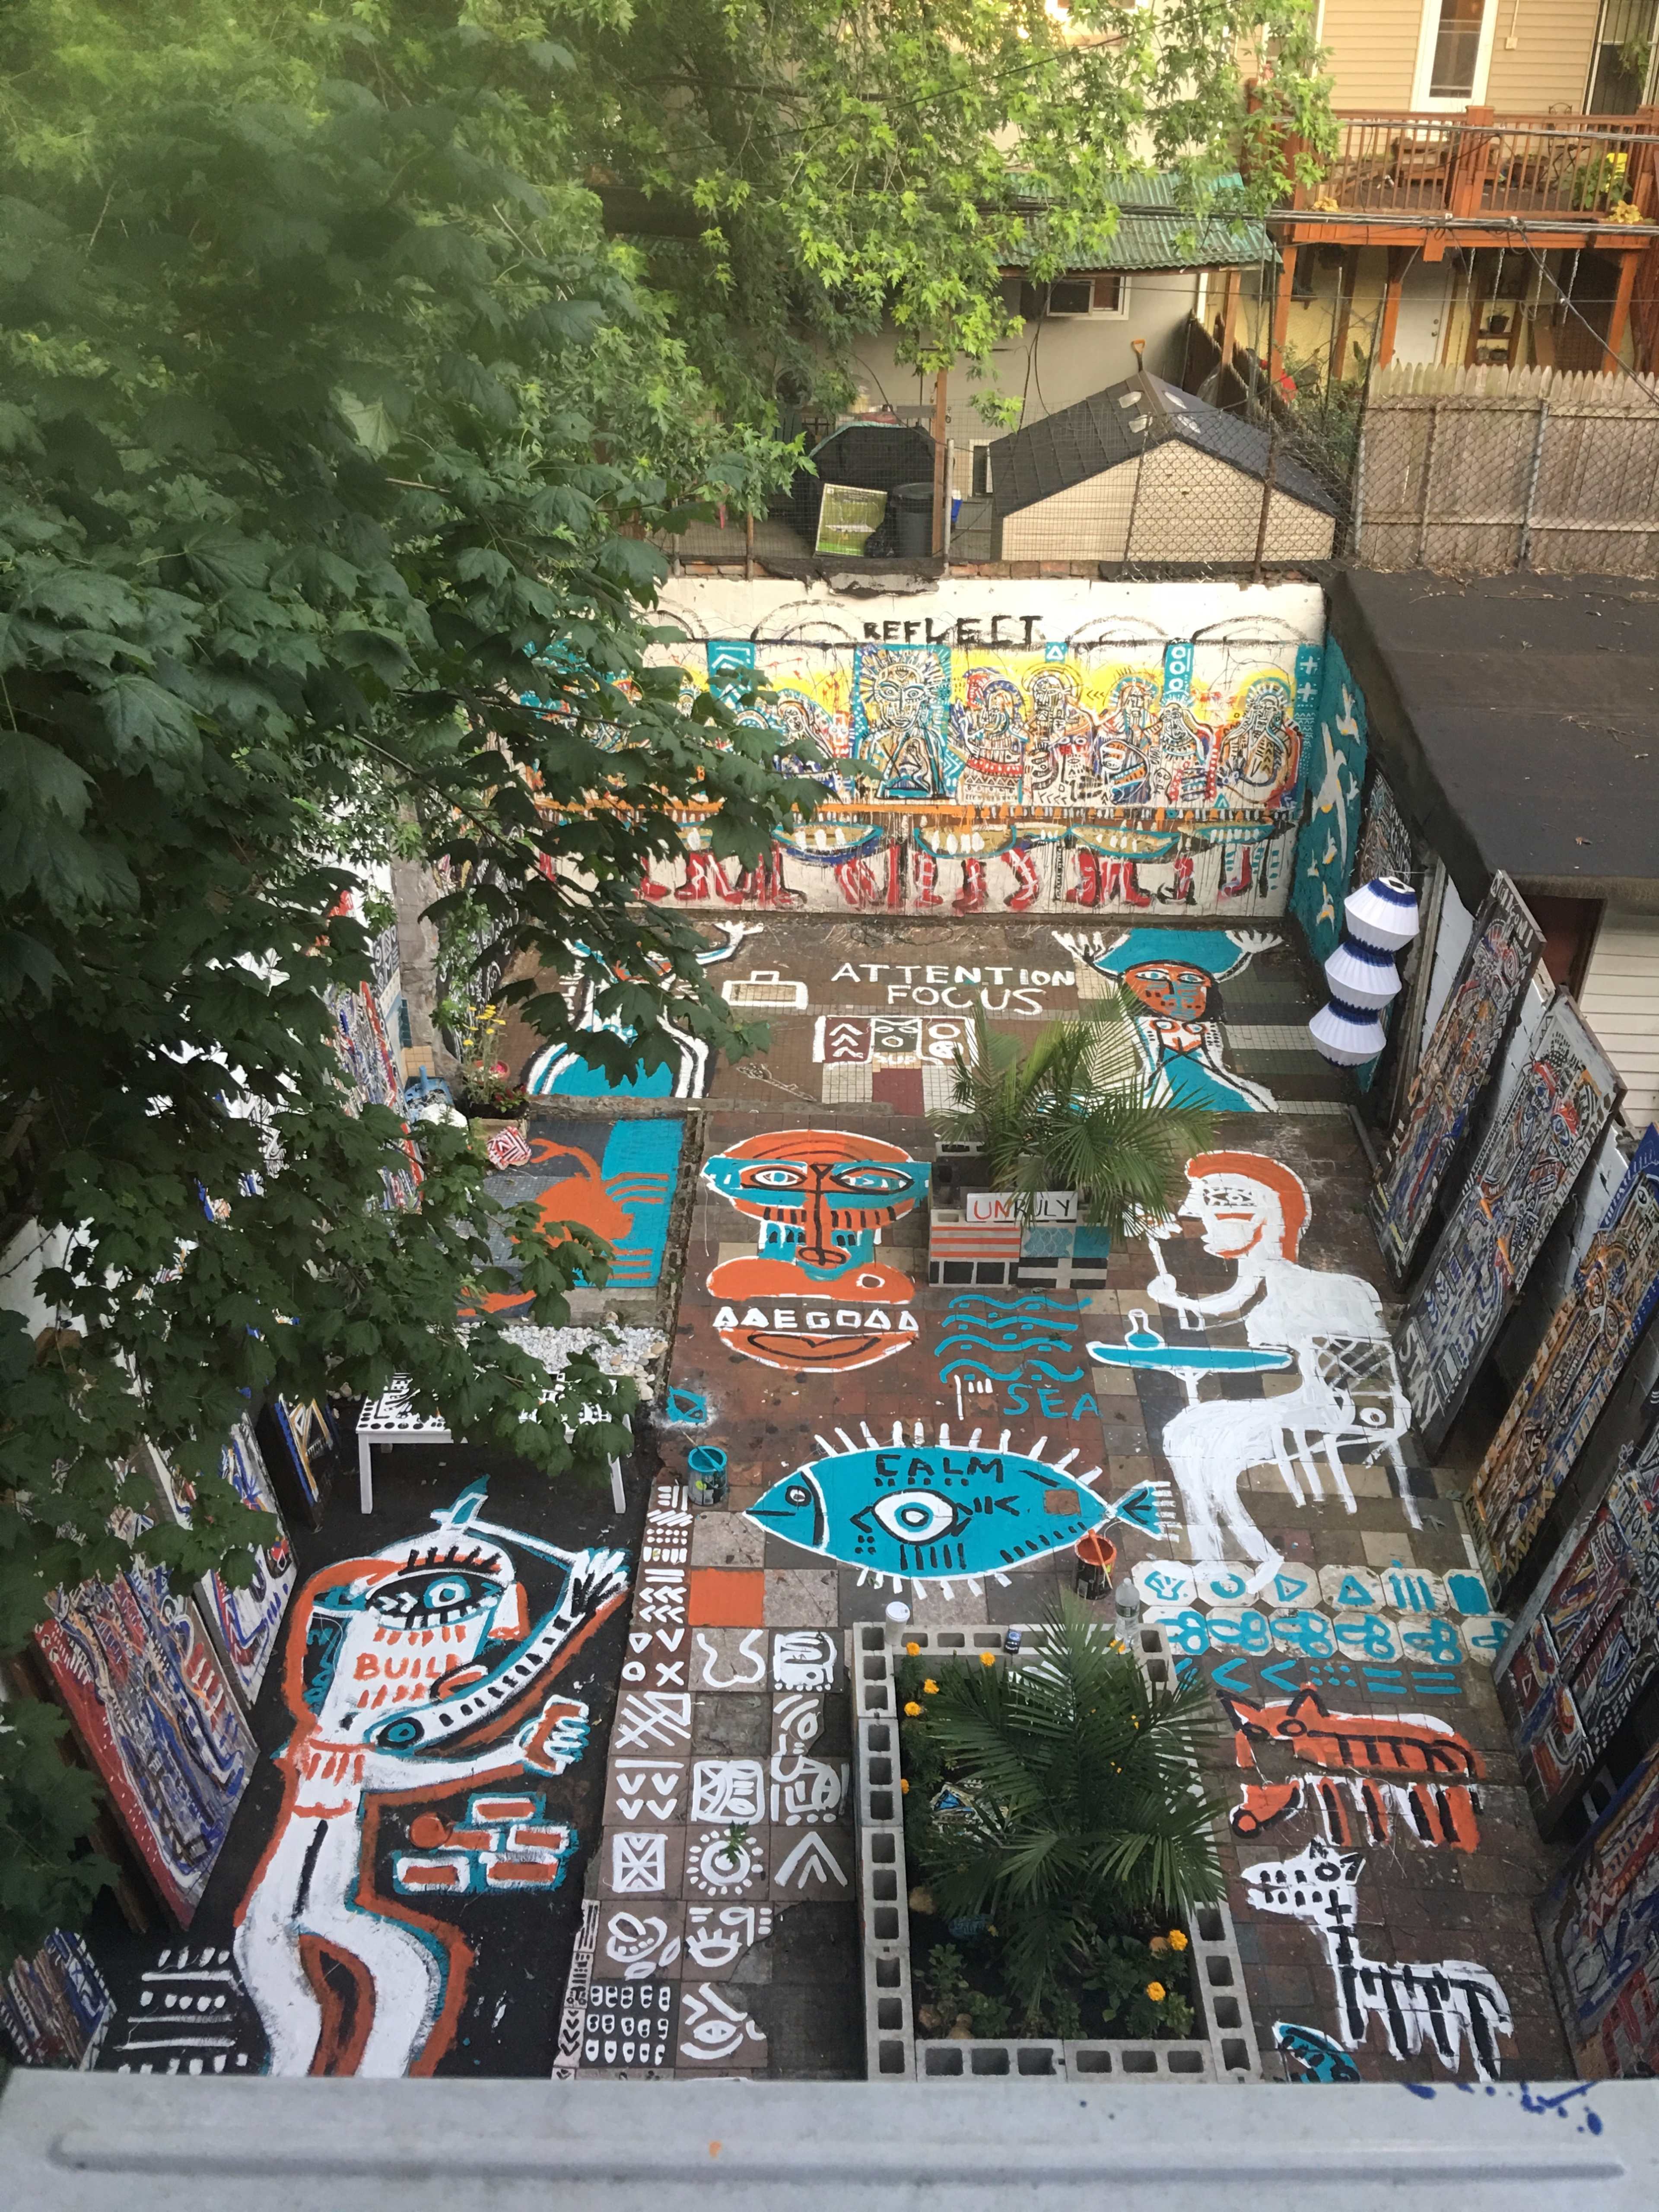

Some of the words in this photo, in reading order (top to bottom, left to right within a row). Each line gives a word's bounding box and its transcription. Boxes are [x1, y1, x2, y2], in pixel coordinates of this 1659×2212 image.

[864, 615, 1043, 645] REFLECT
[831, 963, 1075, 986] ATTENTION
[888, 985, 1046, 1016] FOCUS
[1003, 1383, 1103, 1421] SEA
[875, 1454, 1004, 1483] CALM
